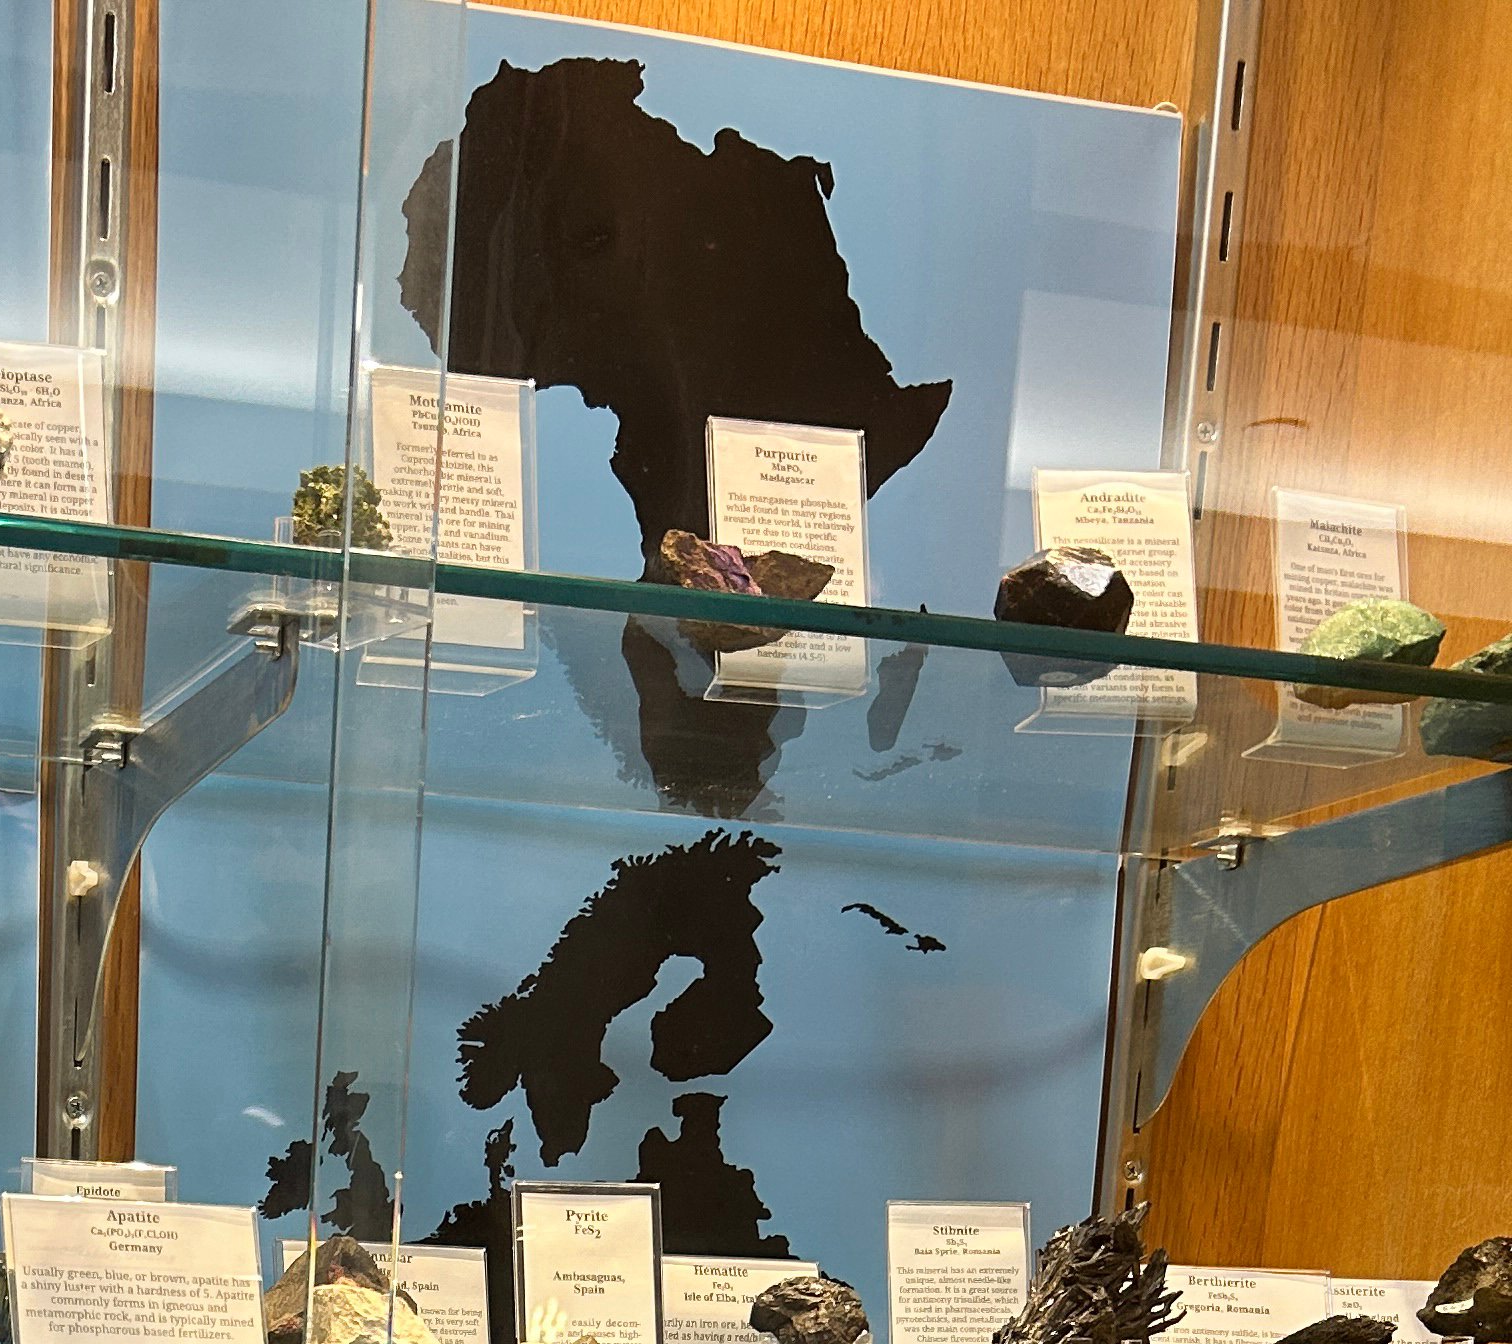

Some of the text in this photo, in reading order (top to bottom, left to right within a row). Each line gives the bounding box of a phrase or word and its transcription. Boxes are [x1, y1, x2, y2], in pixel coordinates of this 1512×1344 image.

[30, 396, 61, 408] Africa
[409, 394, 482, 415] Motamite
[452, 426, 481, 438] Africa
[754, 447, 817, 464] Purpurite
[760, 473, 815, 486] Madagascar
[1080, 492, 1144, 503] Andradite
[1309, 520, 1362, 535] Malachite
[76, 1186, 120, 1199] Epidote
[106, 1210, 159, 1227] Apatite
[566, 1210, 607, 1225] Pyrite
[933, 1225, 979, 1236] Stibnite
[109, 1241, 162, 1255] Germany
[694, 1265, 747, 1277] Hematite
[410, 1281, 439, 1292] Spain
[1188, 1276, 1256, 1289] Berthierite
[574, 1284, 604, 1296] Spain
[1331, 1285, 1385, 1297] ssiterite
[683, 1291, 741, 1304] Isle of Elba,
[1226, 1303, 1270, 1315] Romania
